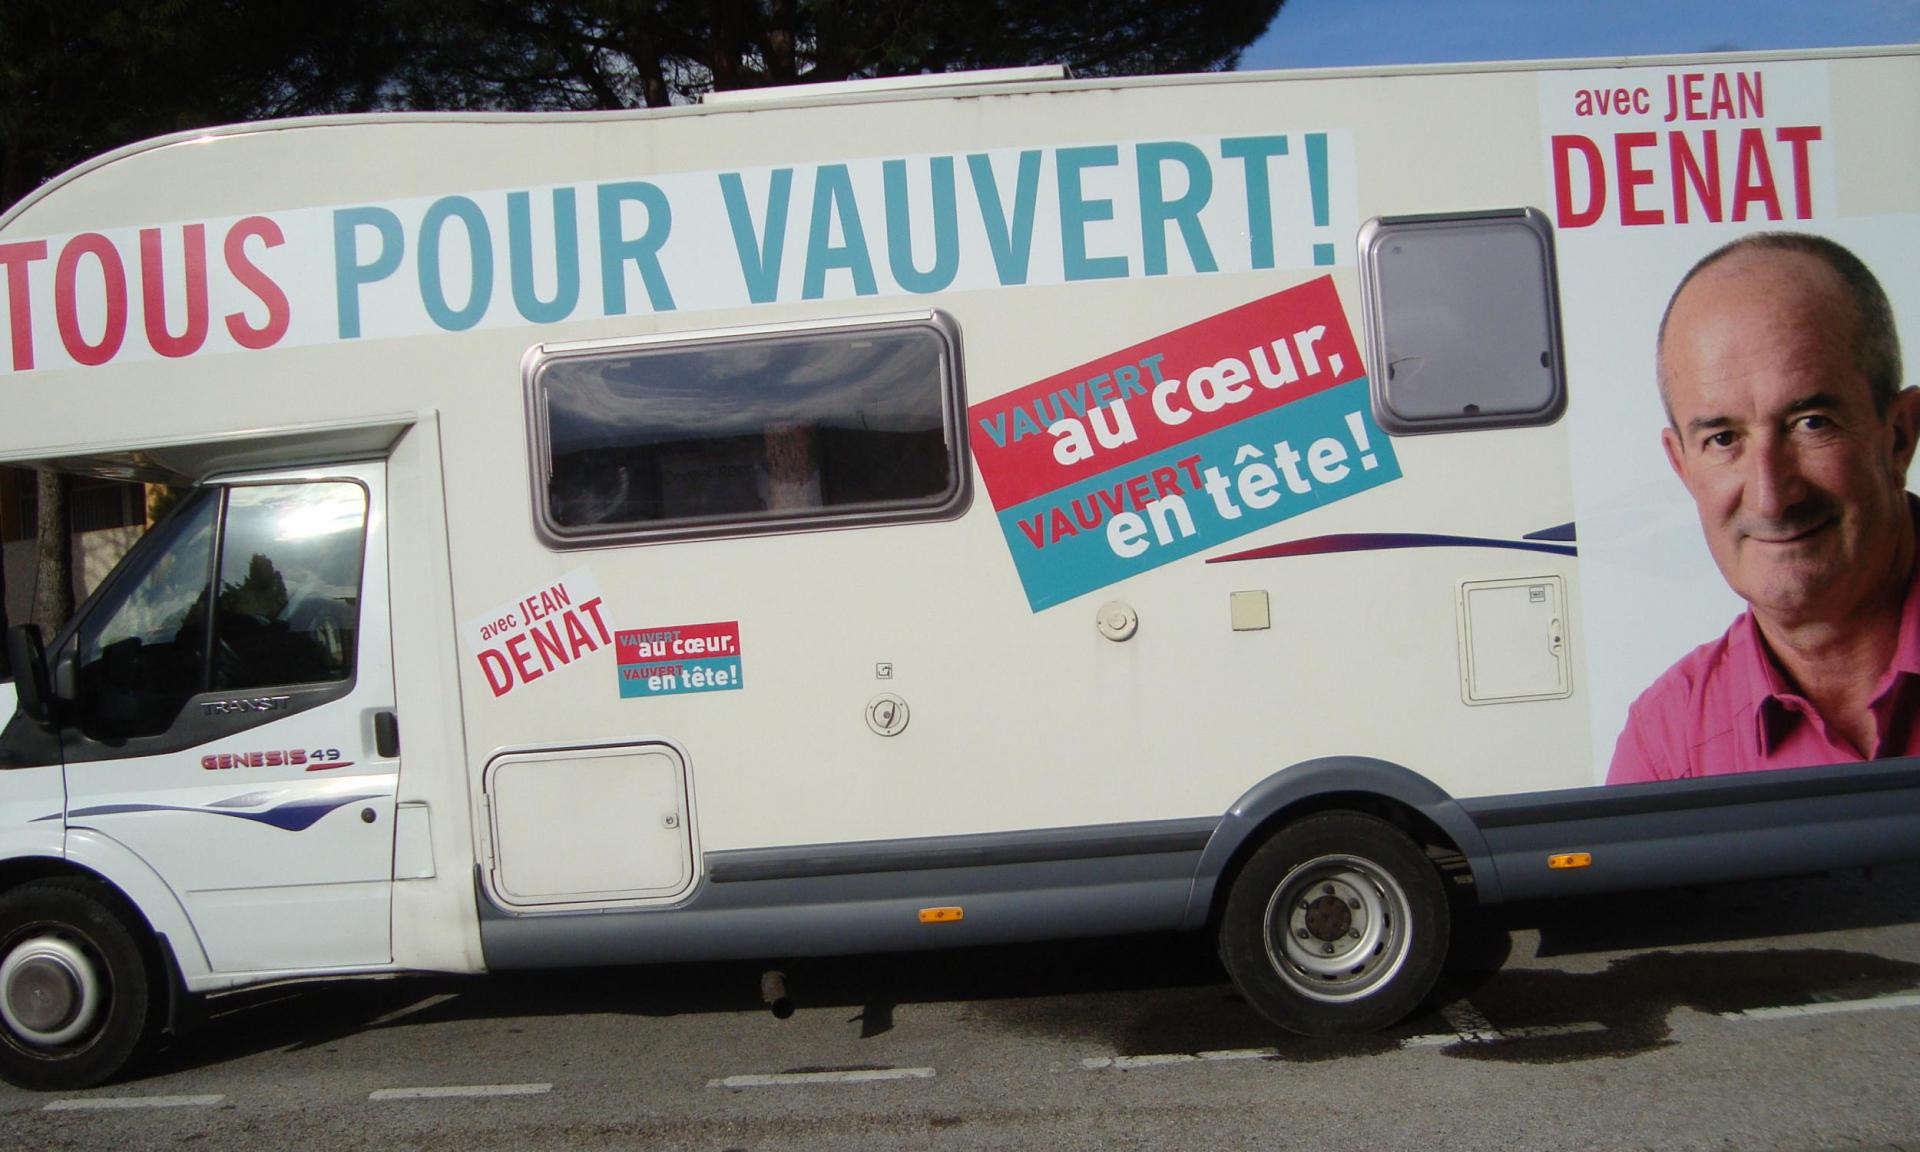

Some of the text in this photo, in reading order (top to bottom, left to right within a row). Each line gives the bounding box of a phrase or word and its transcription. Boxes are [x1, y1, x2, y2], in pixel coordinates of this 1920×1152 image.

[1574, 71, 1765, 122] avec JEAN
[1551, 126, 1822, 229] DENAT
[0, 132, 1336, 372] TOUS POUR VAUVERT!
[979, 353, 1164, 448] VAUVERT
[1047, 324, 1344, 466] au cœur,
[1016, 454, 1205, 551] VAUVERT
[1106, 410, 1379, 559] en tête!
[480, 583, 572, 641] avec JEAN
[619, 630, 681, 647] VAUVERT
[477, 596, 613, 698] DENAT
[623, 664, 684, 681] VAUVERT
[638, 633, 735, 658] au cœur,
[200, 695, 291, 716] TRANSIT
[648, 664, 738, 691] en tête!
[201, 748, 341, 770] GENESIS 49
